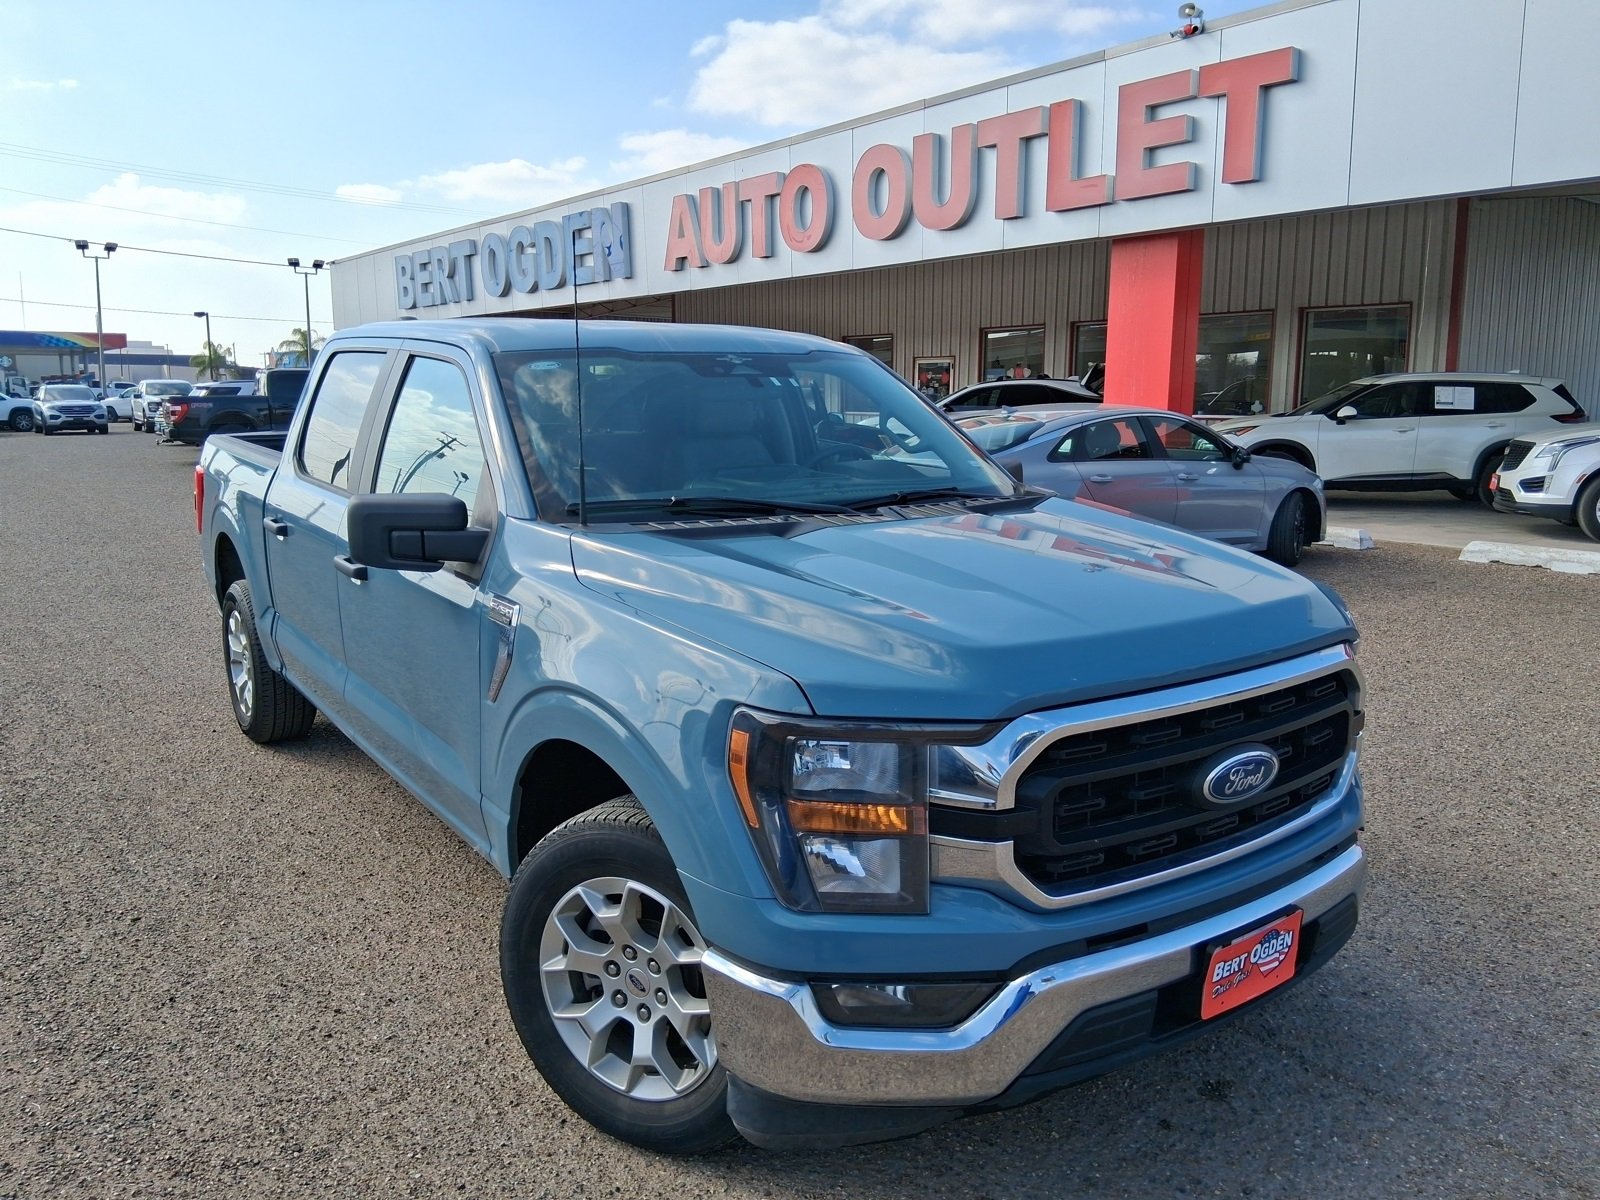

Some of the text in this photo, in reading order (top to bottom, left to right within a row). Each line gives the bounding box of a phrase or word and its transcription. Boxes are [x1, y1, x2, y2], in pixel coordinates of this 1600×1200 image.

[664, 45, 1300, 272] AUTO OUTLET
[395, 202, 632, 309] BERT OGDEN
[1225, 763, 1264, 795] Ford
[1212, 930, 1293, 983] BERT OGDEN
